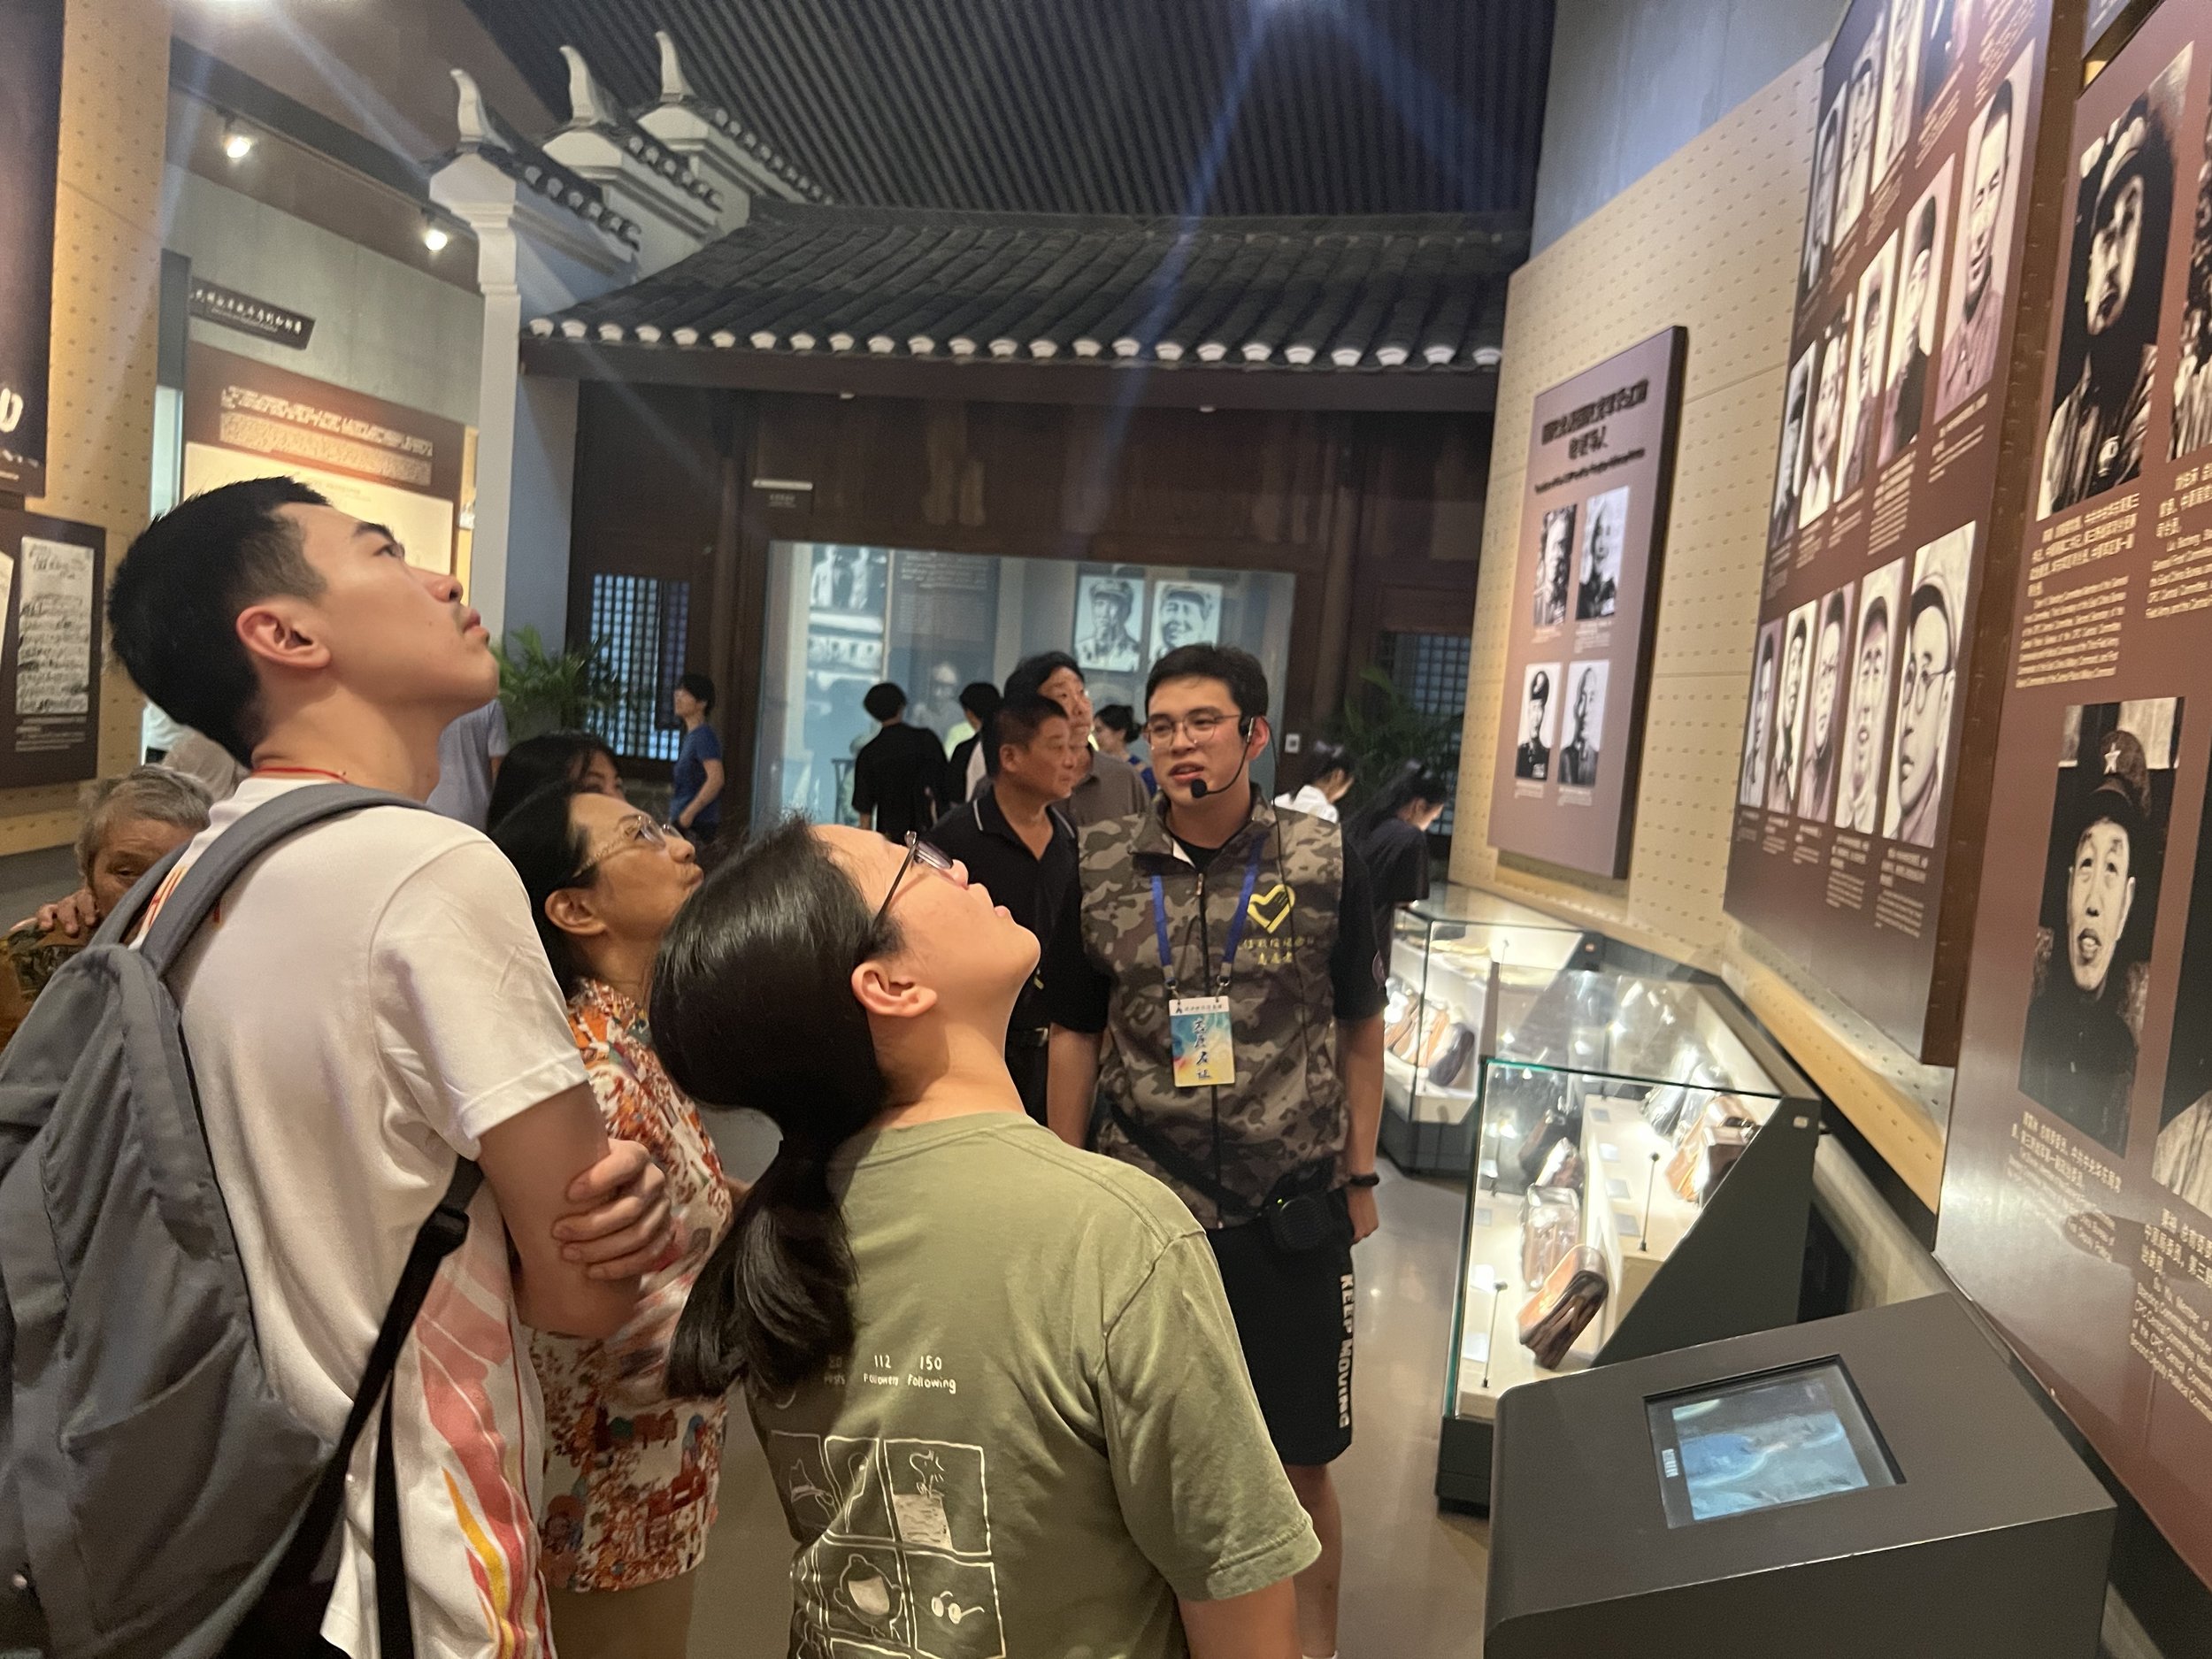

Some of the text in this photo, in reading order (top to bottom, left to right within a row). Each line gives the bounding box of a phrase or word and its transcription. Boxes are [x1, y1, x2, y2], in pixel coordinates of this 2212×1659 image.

[1338, 1273, 1355, 1429] KEEP MOVING
[874, 1354, 892, 1369] 112
[919, 1355, 942, 1371] 150
[907, 1373, 956, 1394] Following
